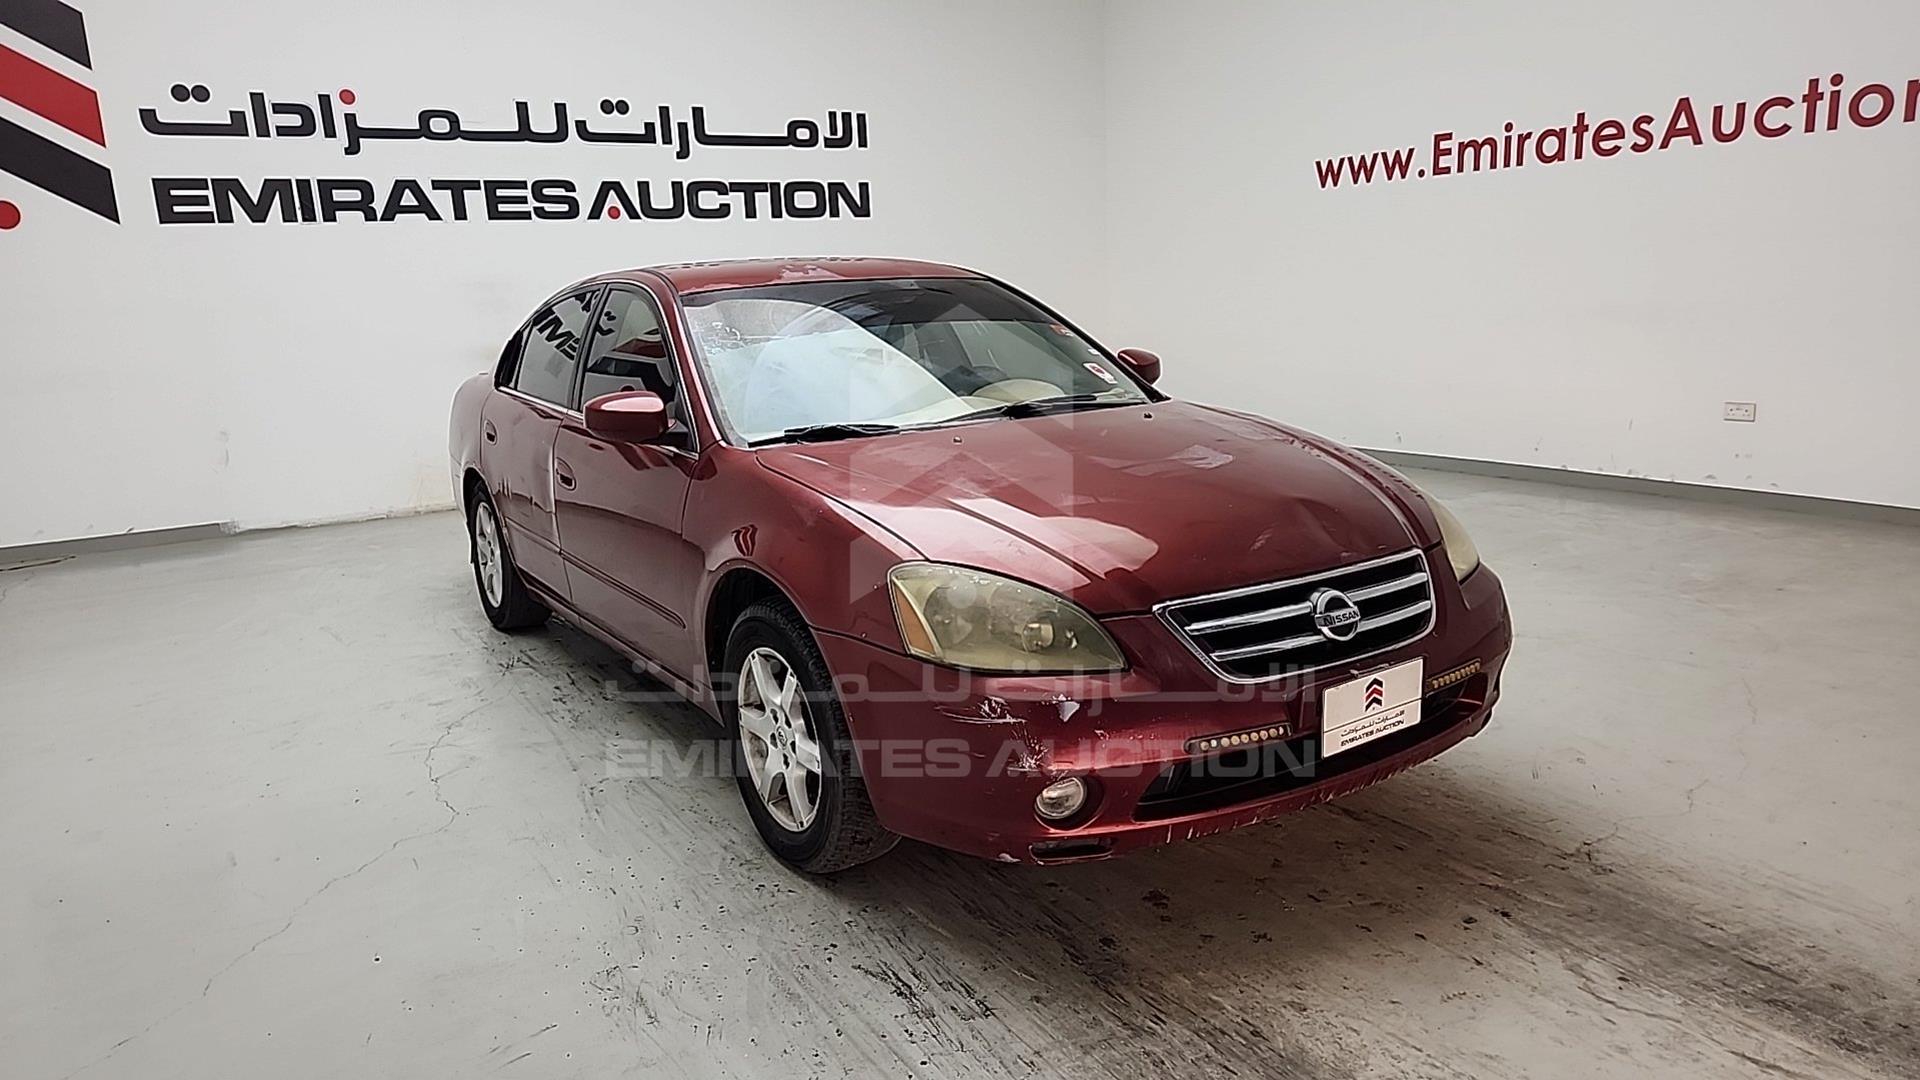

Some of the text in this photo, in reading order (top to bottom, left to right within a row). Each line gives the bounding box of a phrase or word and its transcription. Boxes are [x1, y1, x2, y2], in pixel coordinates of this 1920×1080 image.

[139, 84, 569, 156] للمزادات
[152, 178, 871, 225] EMIRATES AUCTION
[1322, 609, 1360, 626] NISSAN
